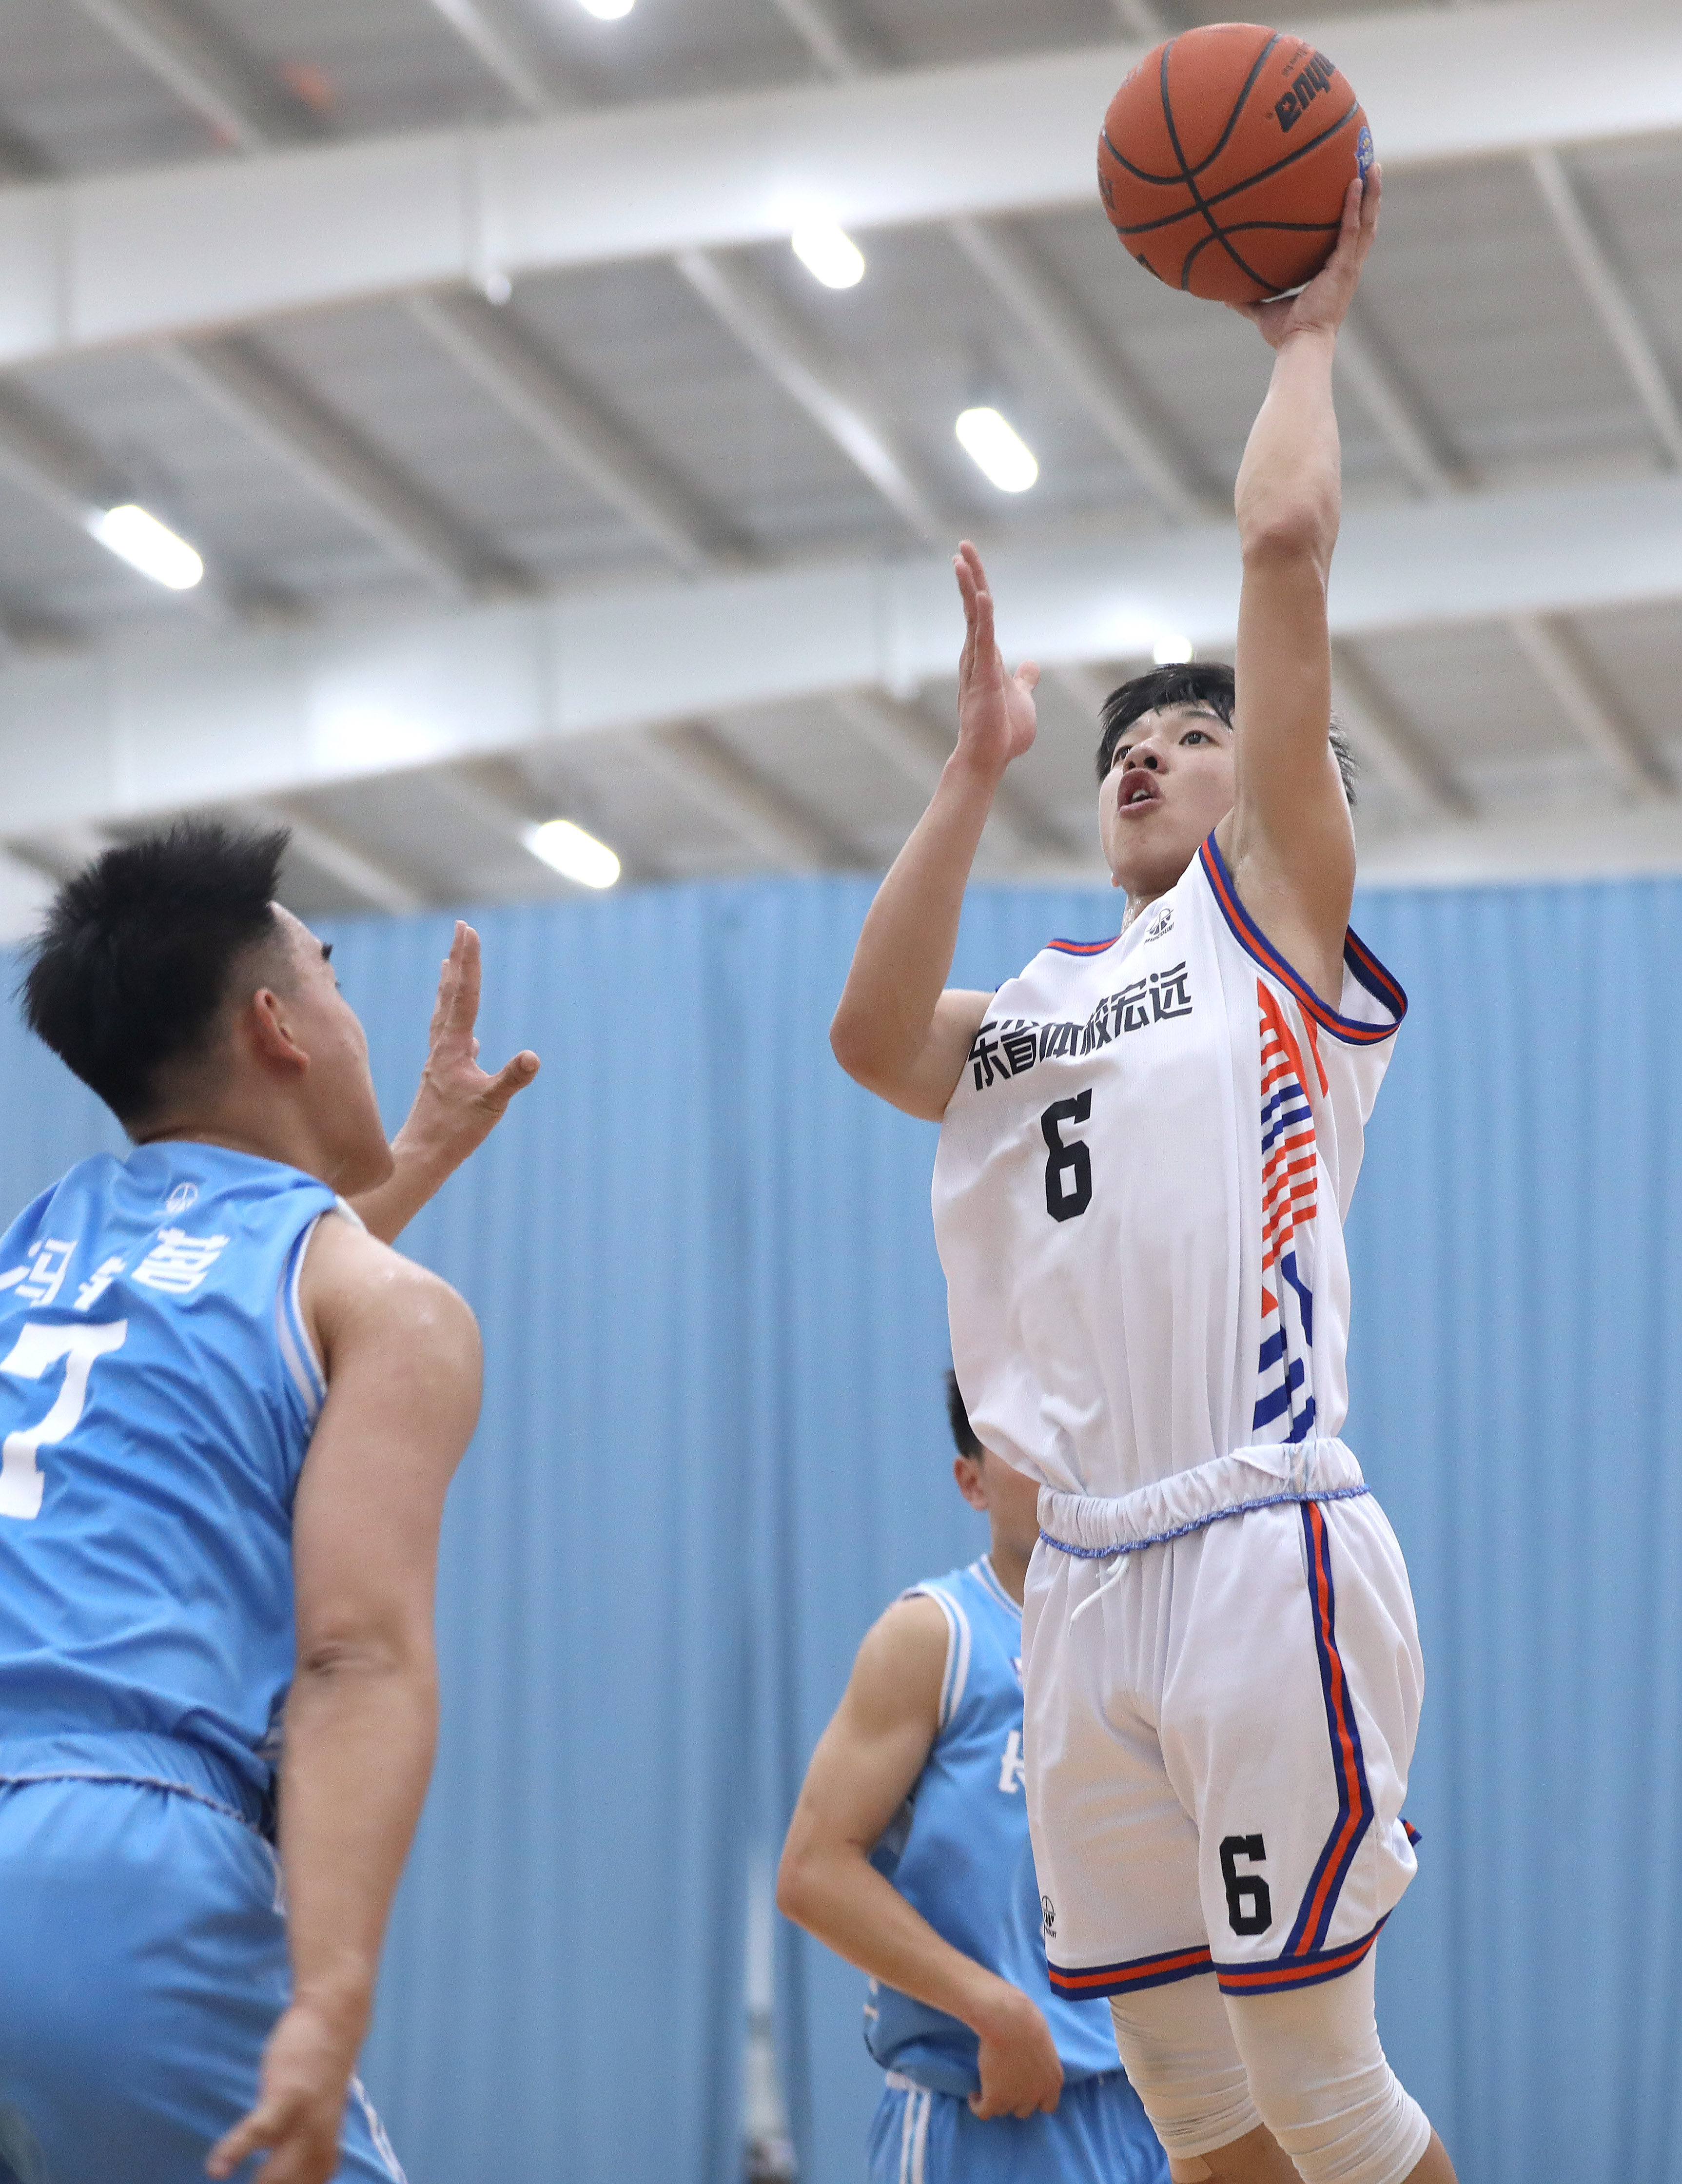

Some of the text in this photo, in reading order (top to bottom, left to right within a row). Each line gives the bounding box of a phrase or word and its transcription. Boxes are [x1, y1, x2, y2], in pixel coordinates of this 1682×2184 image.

[1041, 1088, 1092, 1222] 6
[0, 1319, 128, 1520] 7
[1219, 1833, 1272, 1935] 6
